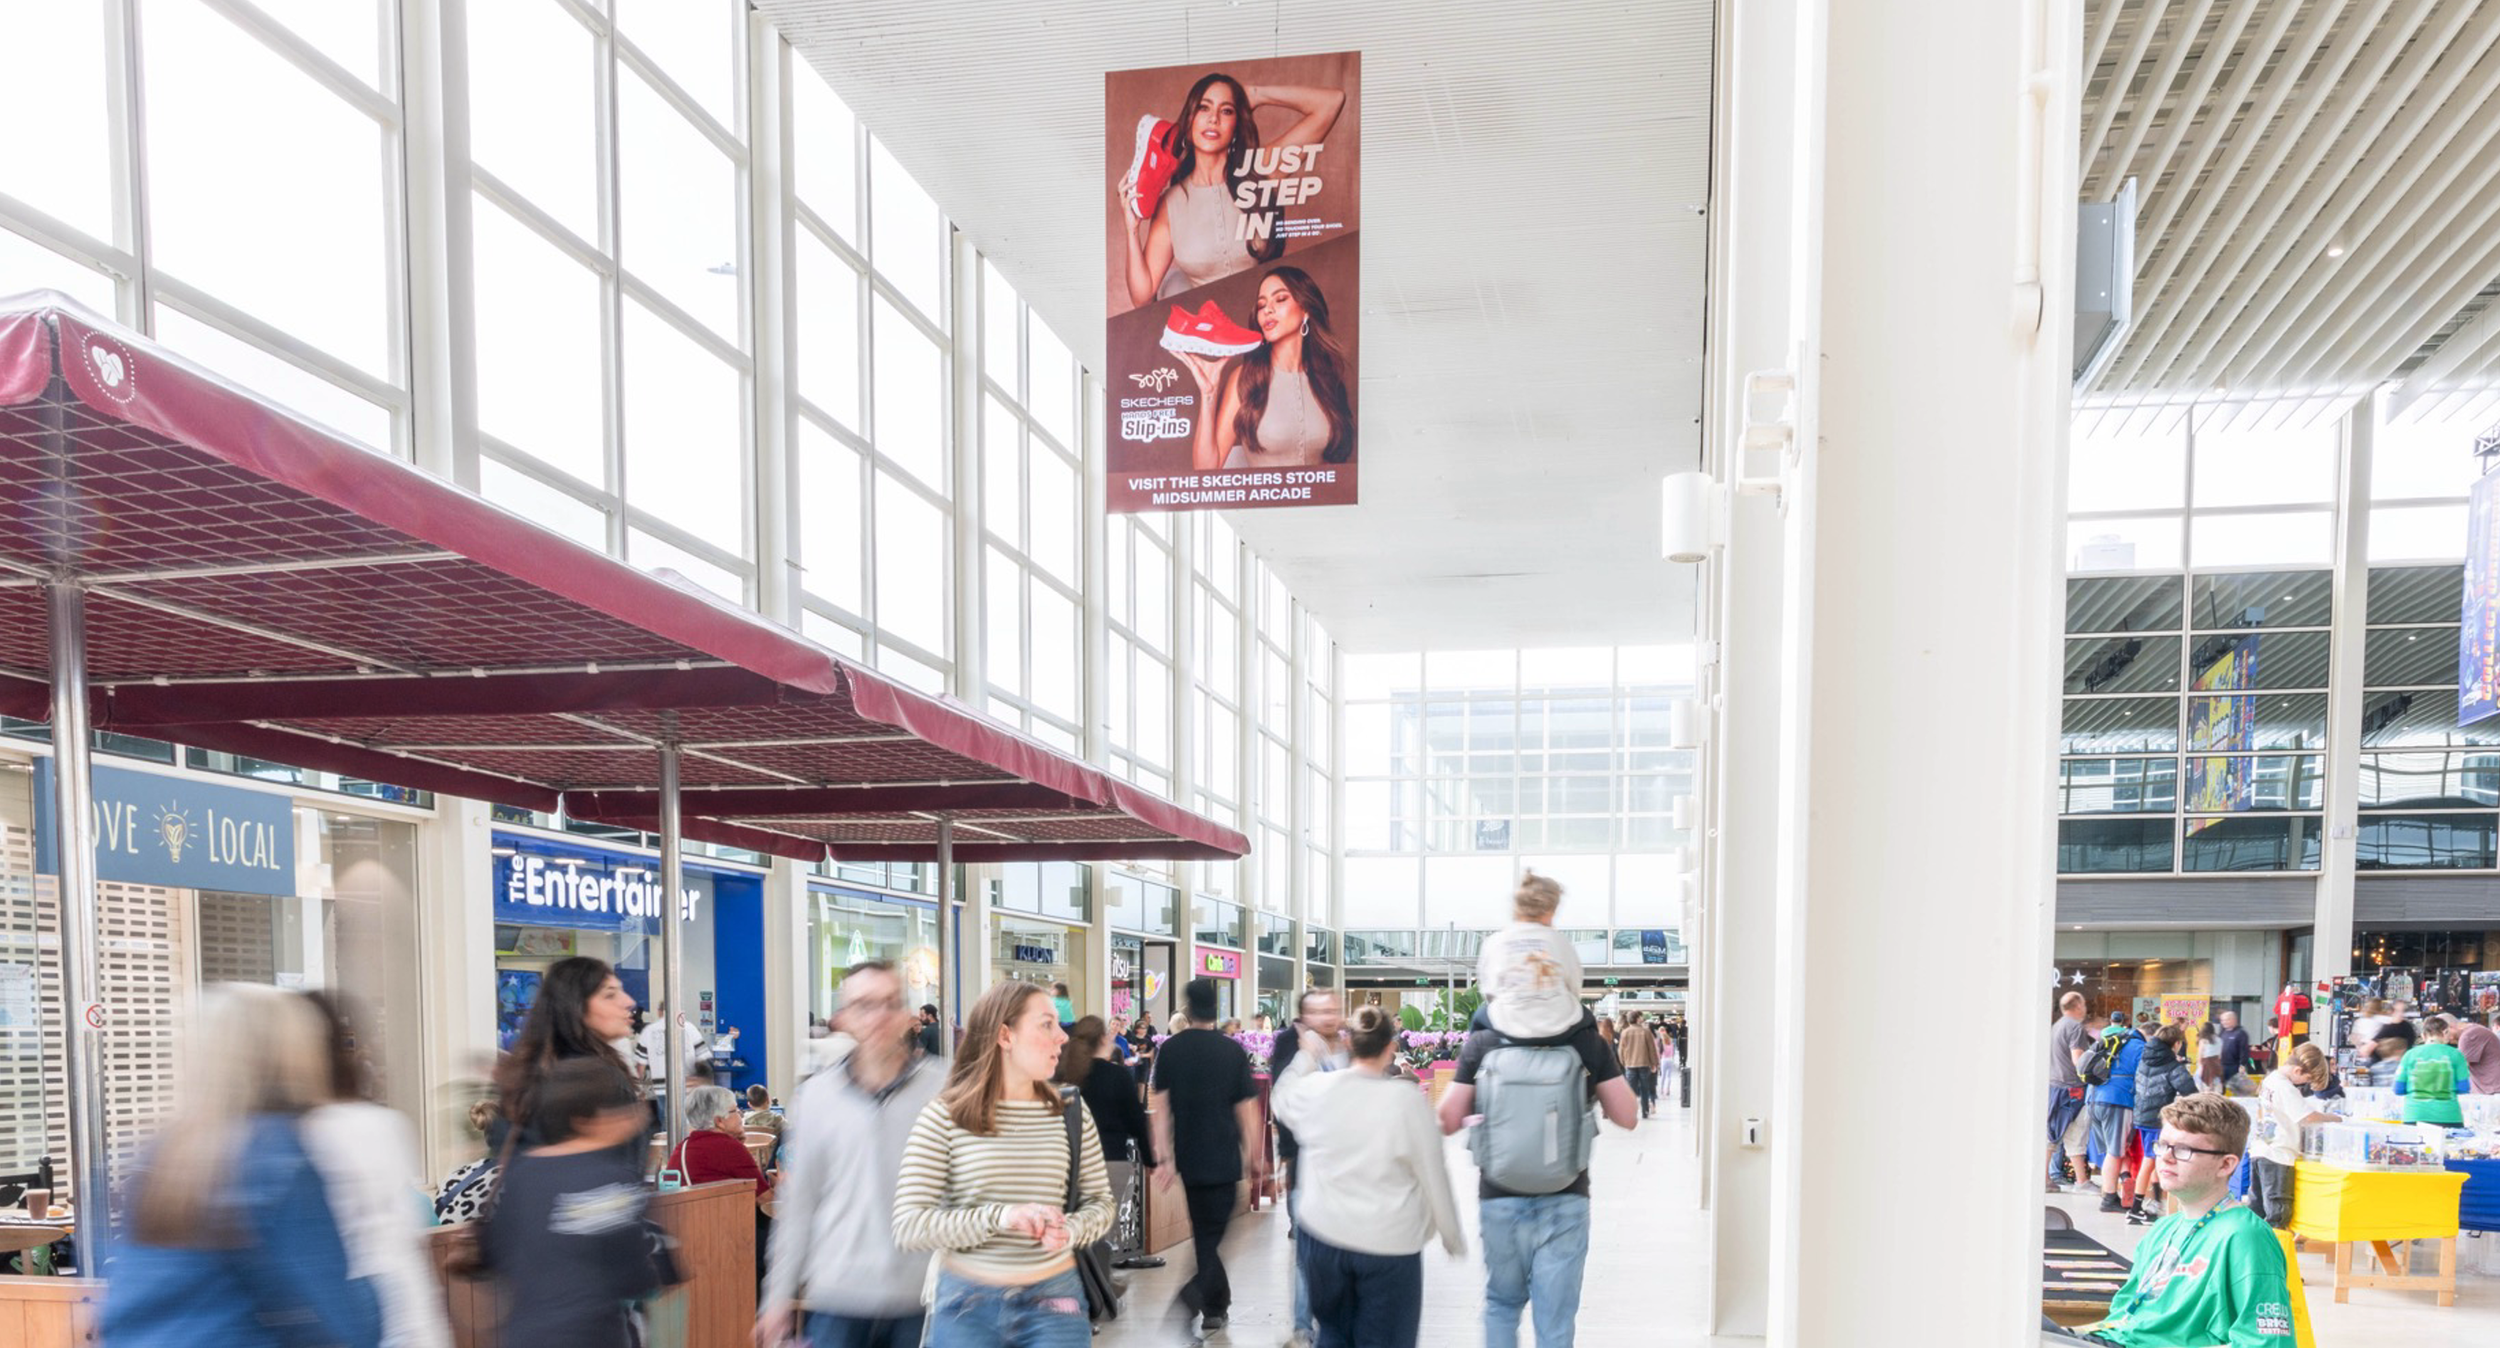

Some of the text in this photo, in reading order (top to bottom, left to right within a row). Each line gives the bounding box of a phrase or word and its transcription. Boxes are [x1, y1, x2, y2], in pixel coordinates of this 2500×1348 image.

[1233, 143, 1324, 177] JUST
[1234, 176, 1323, 209] STEP
[1235, 211, 1274, 240] IN
[1121, 396, 1194, 408] SKECHERS
[1121, 411, 1152, 420] HANDS
[1123, 418, 1189, 440] Slip-ins
[1128, 471, 1336, 490] VISIT THE SKECHERS STORE
[1152, 487, 1311, 505] MIDSUMMER ARCADE
[208, 809, 280, 870] LOCAL
[508, 855, 525, 903] The
[1112, 951, 1130, 978] itsu
[2256, 1302, 2288, 1317] CREW
